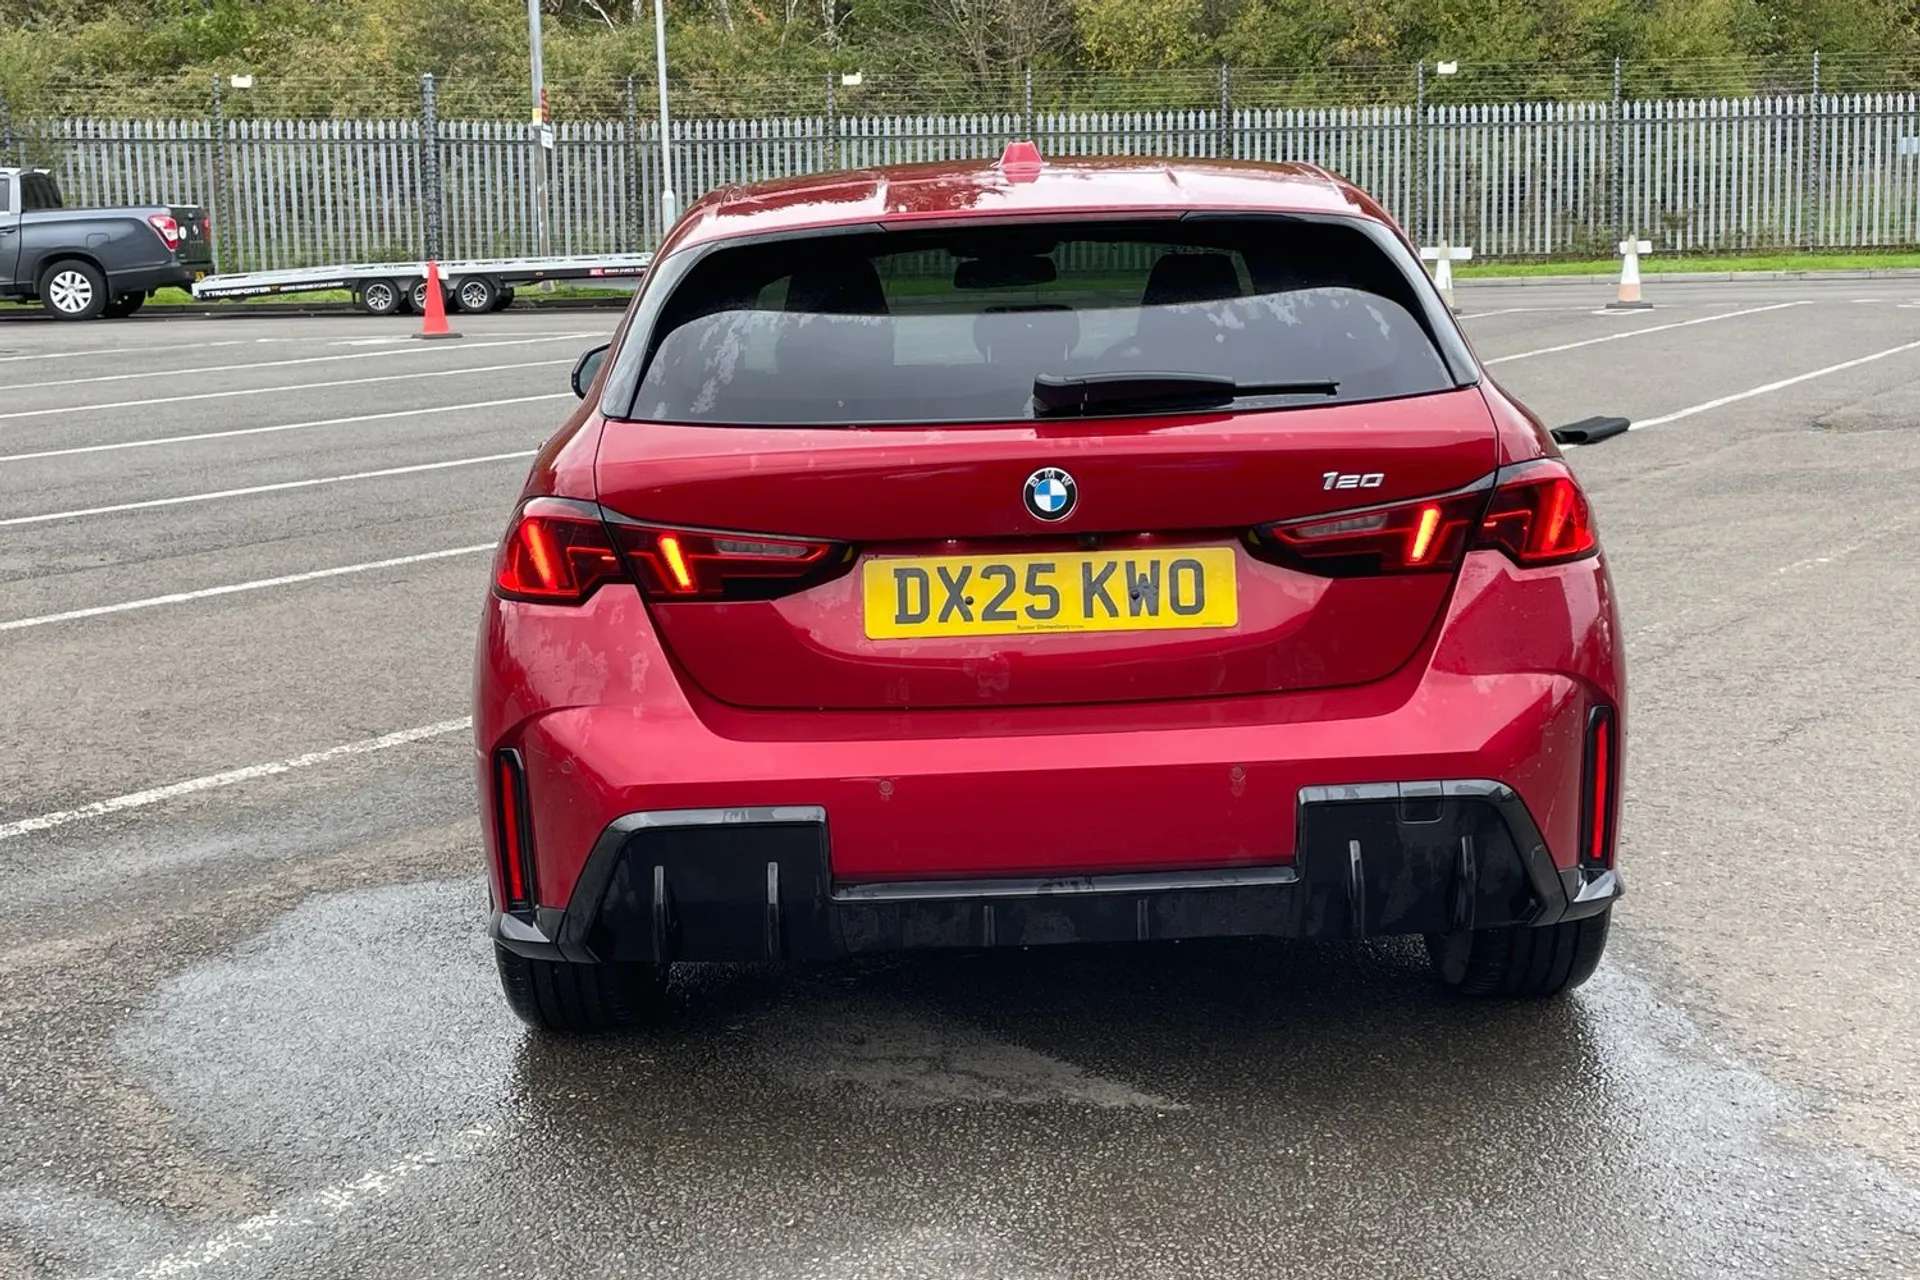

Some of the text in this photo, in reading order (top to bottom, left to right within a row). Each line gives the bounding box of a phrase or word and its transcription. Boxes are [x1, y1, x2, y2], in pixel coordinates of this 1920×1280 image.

[1028, 469, 1073, 488] BMW
[1323, 471, 1385, 490] 120
[893, 559, 1205, 625] DX25 KWO
